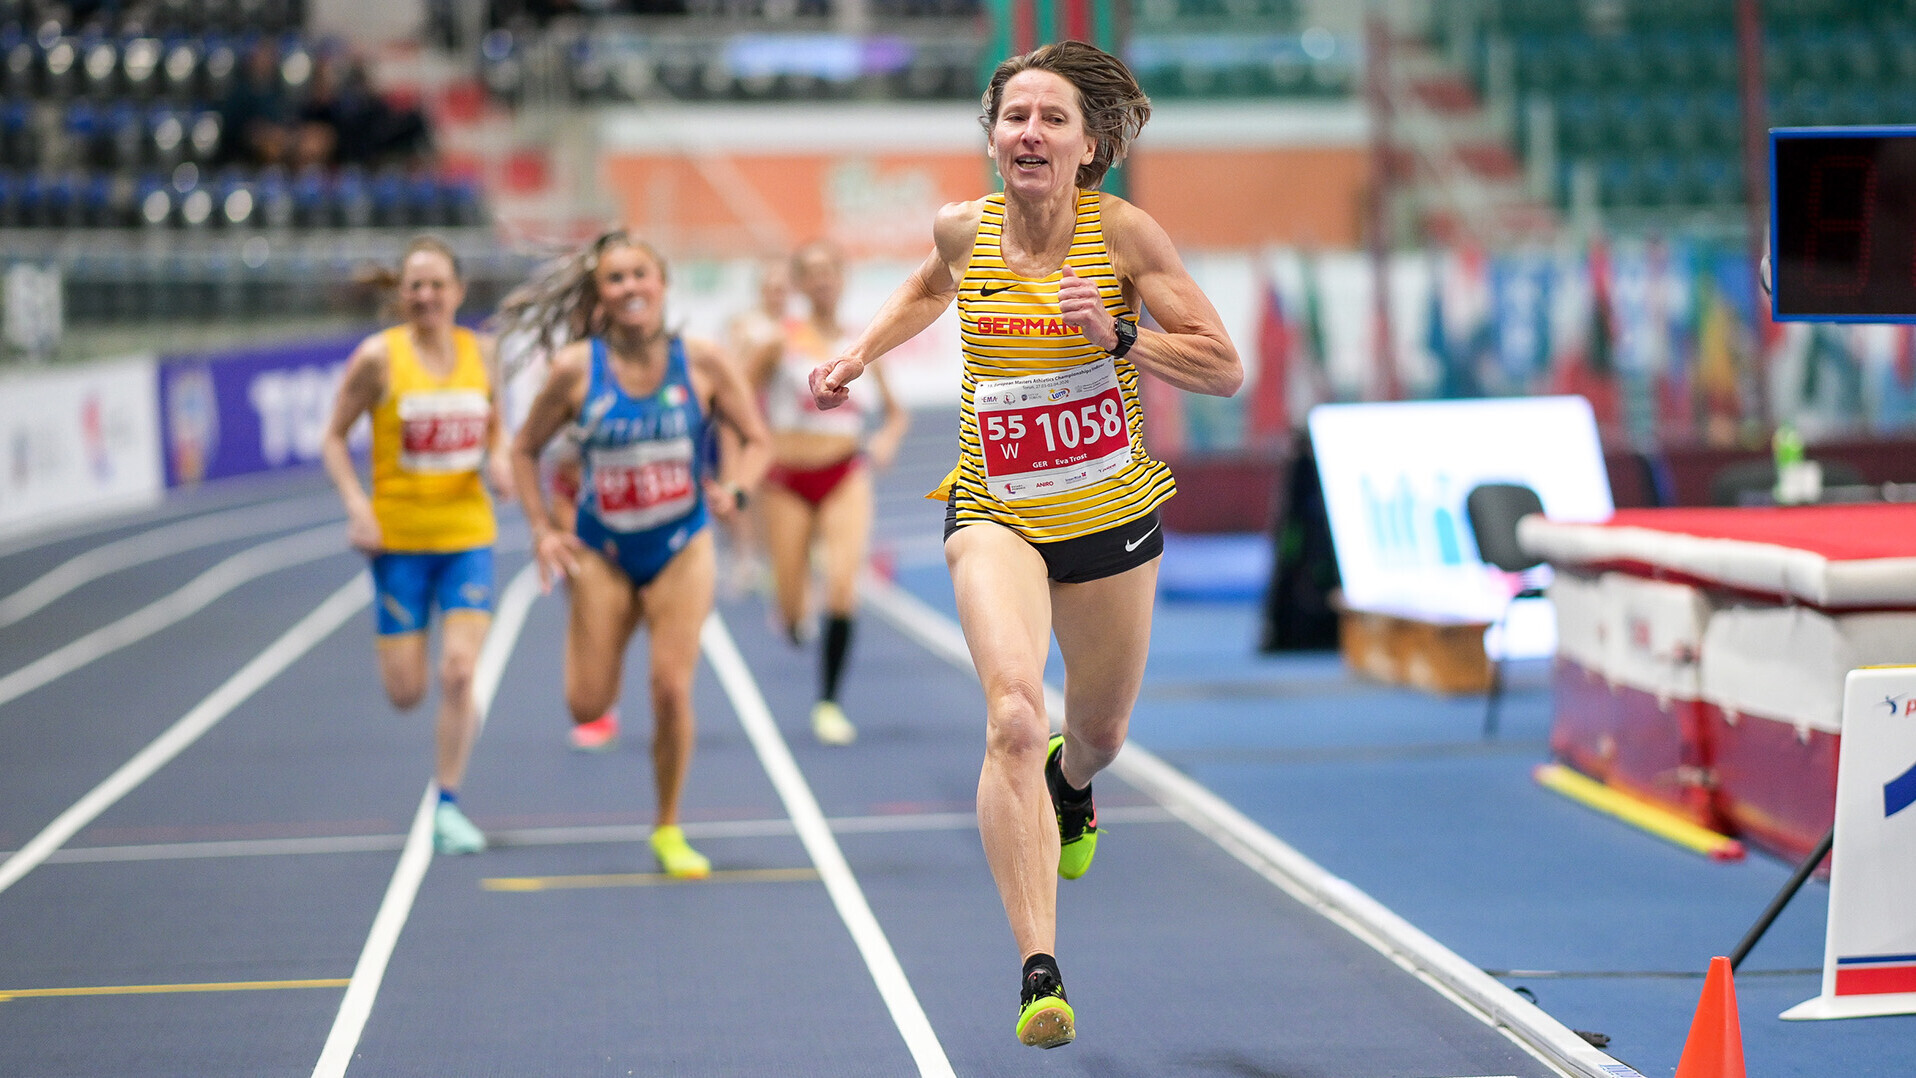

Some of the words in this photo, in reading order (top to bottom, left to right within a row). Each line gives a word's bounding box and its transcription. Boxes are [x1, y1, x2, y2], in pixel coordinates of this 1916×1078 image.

[978, 316, 1079, 335] GERMAN
[1055, 369, 1092, 380] Championships
[1051, 390, 1067, 400] LOTTO
[987, 414, 1027, 441] 55
[1035, 398, 1122, 452] 1058
[1000, 442, 1019, 460] W
[1032, 460, 1048, 468] GER
[1055, 458, 1069, 466] Eva
[1069, 453, 1088, 463] Trost
